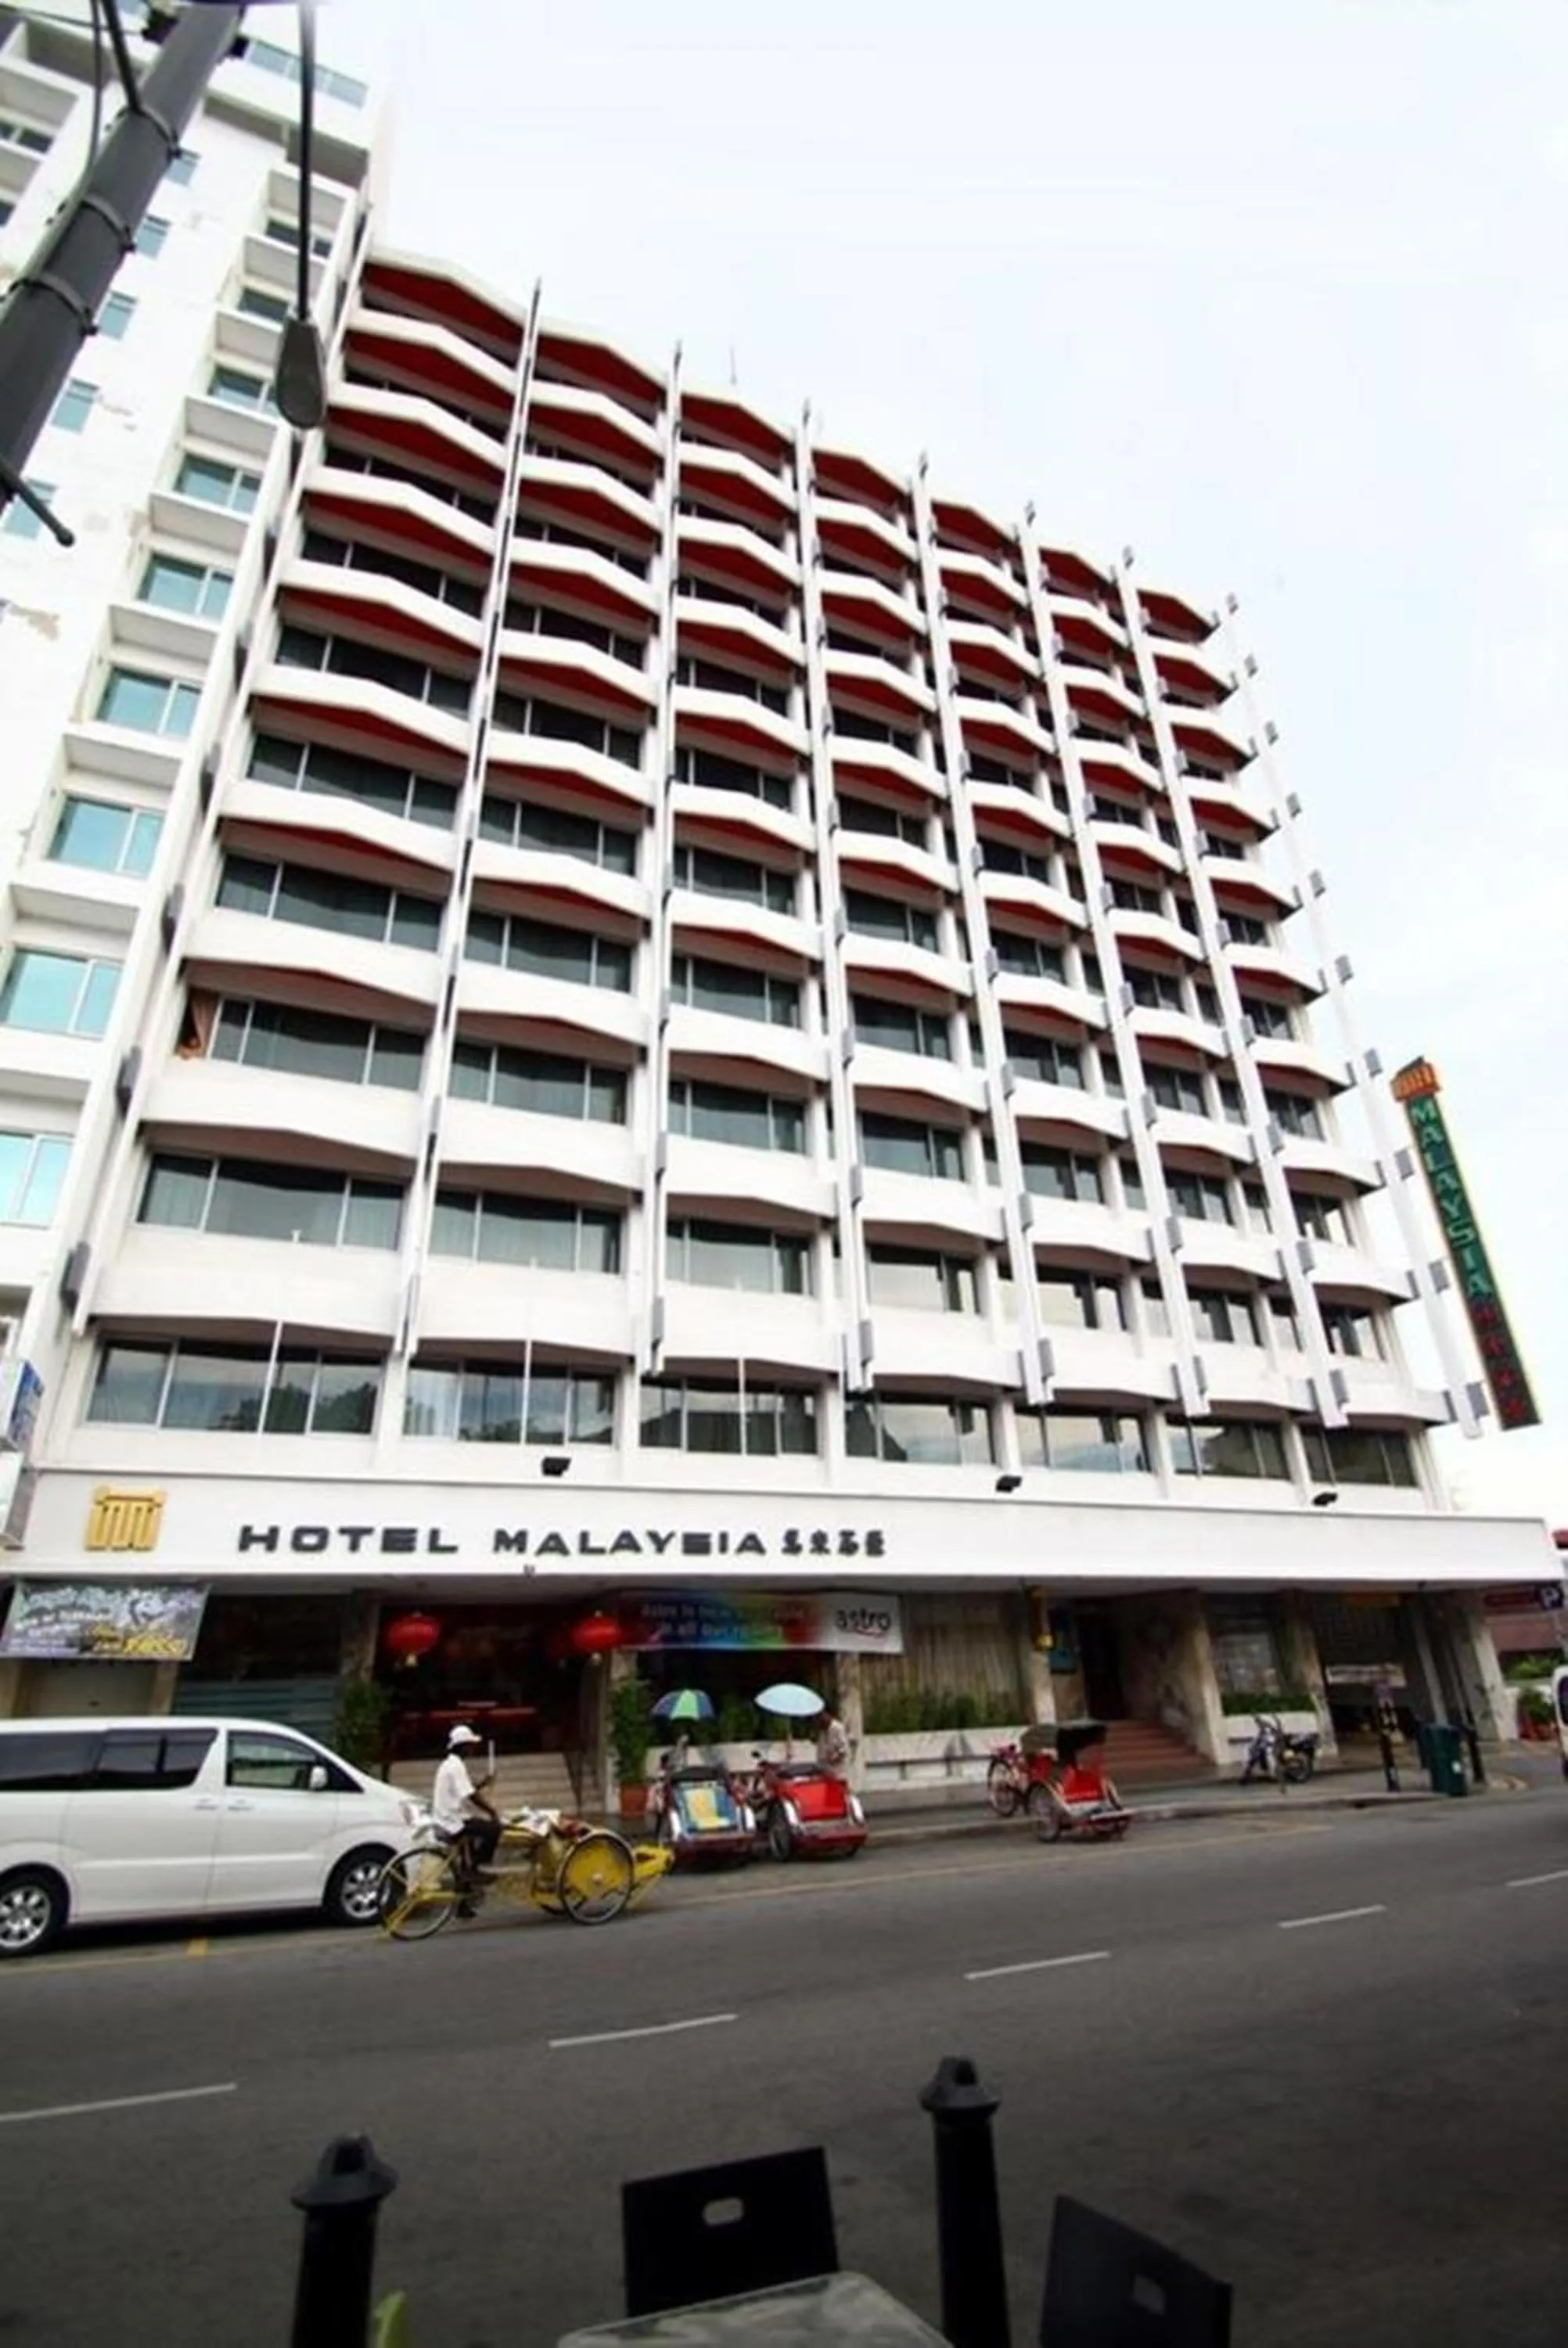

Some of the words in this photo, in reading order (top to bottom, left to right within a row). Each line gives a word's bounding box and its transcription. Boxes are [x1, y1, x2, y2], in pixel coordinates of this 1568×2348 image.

[1410, 1099, 1493, 1297] MALAYSIA
[238, 1525, 459, 1554] HOTEL
[493, 1528, 766, 1556] MALAYSIA
[835, 1608, 891, 1633] astro
